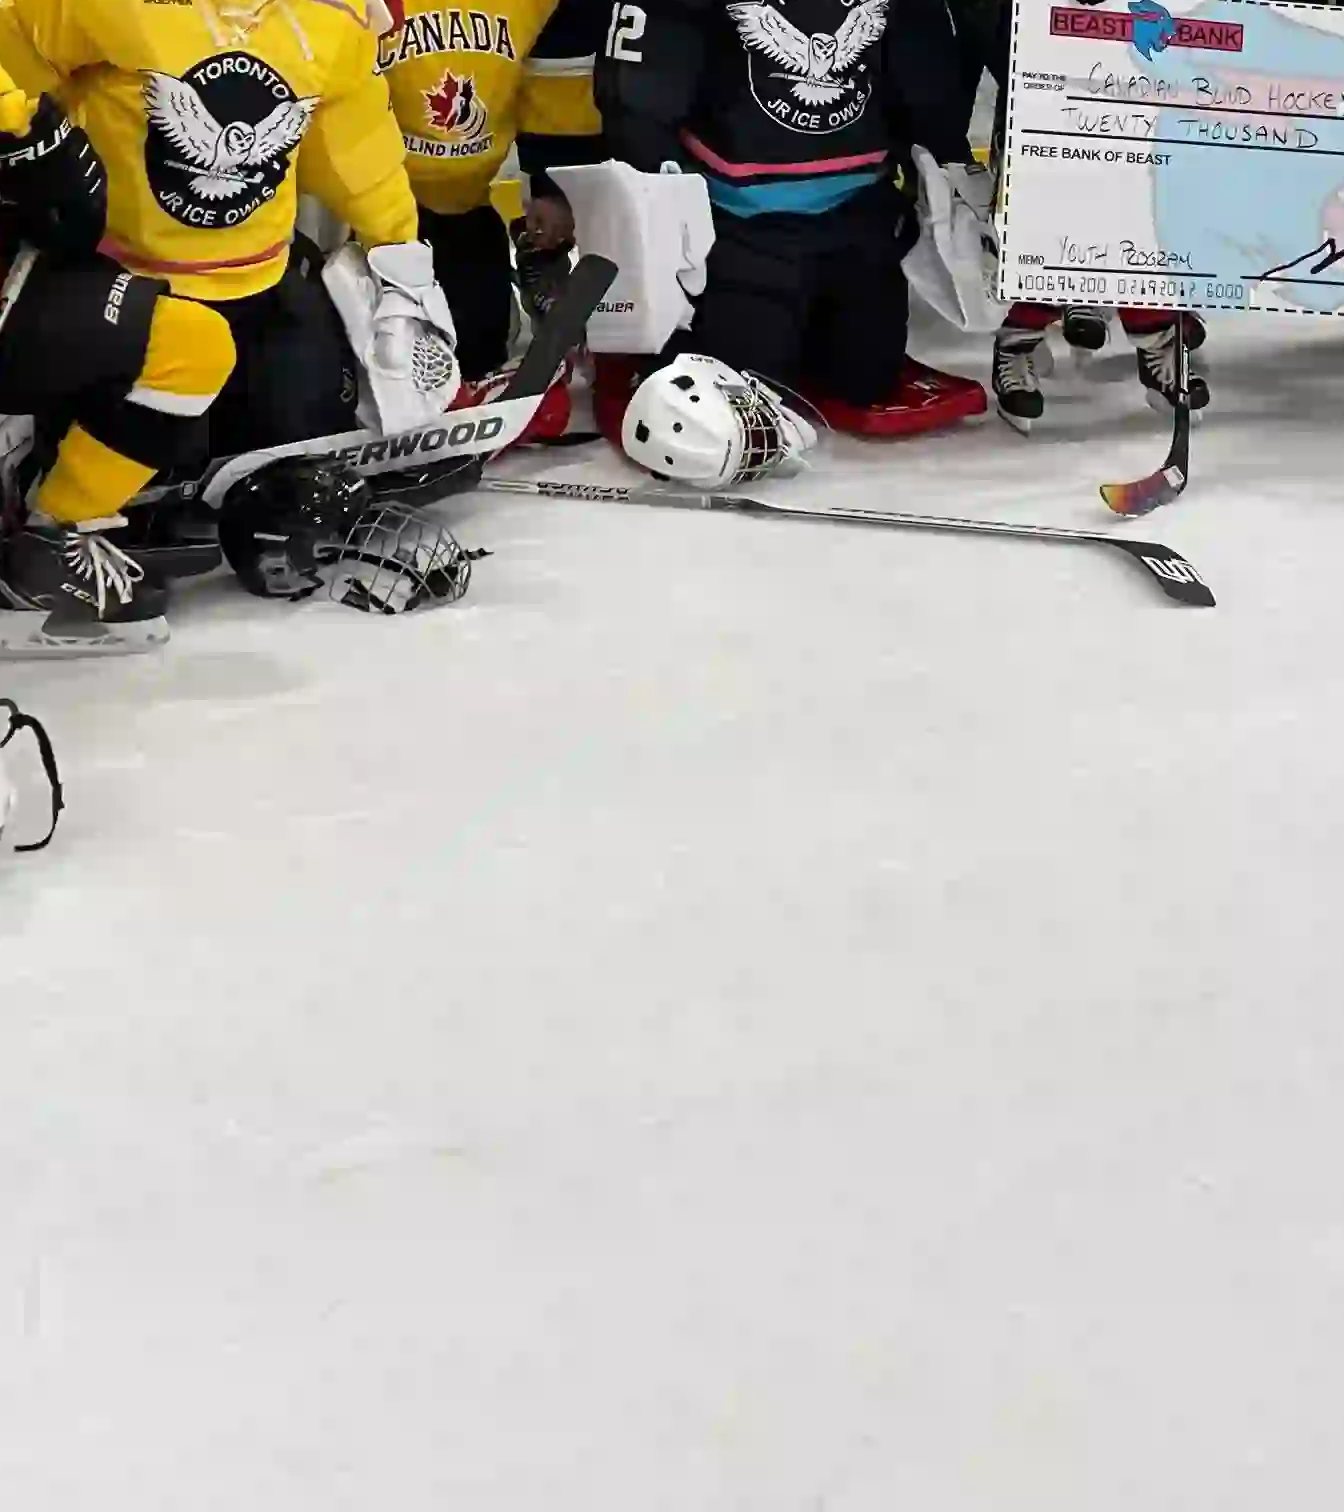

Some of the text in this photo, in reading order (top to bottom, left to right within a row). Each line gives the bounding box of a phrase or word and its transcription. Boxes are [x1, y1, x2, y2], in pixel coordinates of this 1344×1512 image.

[372, 9, 518, 77] CANADA
[605, 1, 647, 62] 12
[1053, 13, 1241, 48] BEAST BANK
[193, 56, 290, 101] TORONTO
[1087, 62, 1181, 101] CANADIAN
[1191, 77, 1252, 107] BLIND
[767, 90, 867, 129] JR ICE OWLS
[1061, 106, 1319, 149] TWENTY THOUSAND
[1021, 144, 1173, 167] FREE BANK OF BEAST
[158, 190, 184, 213] JR
[182, 202, 217, 226] ICE
[1018, 254, 1045, 266] MEMO
[1058, 235, 1194, 270] YOUTH PROGRAM
[596, 301, 635, 314] AUER
[328, 416, 506, 466] ERWOOD
